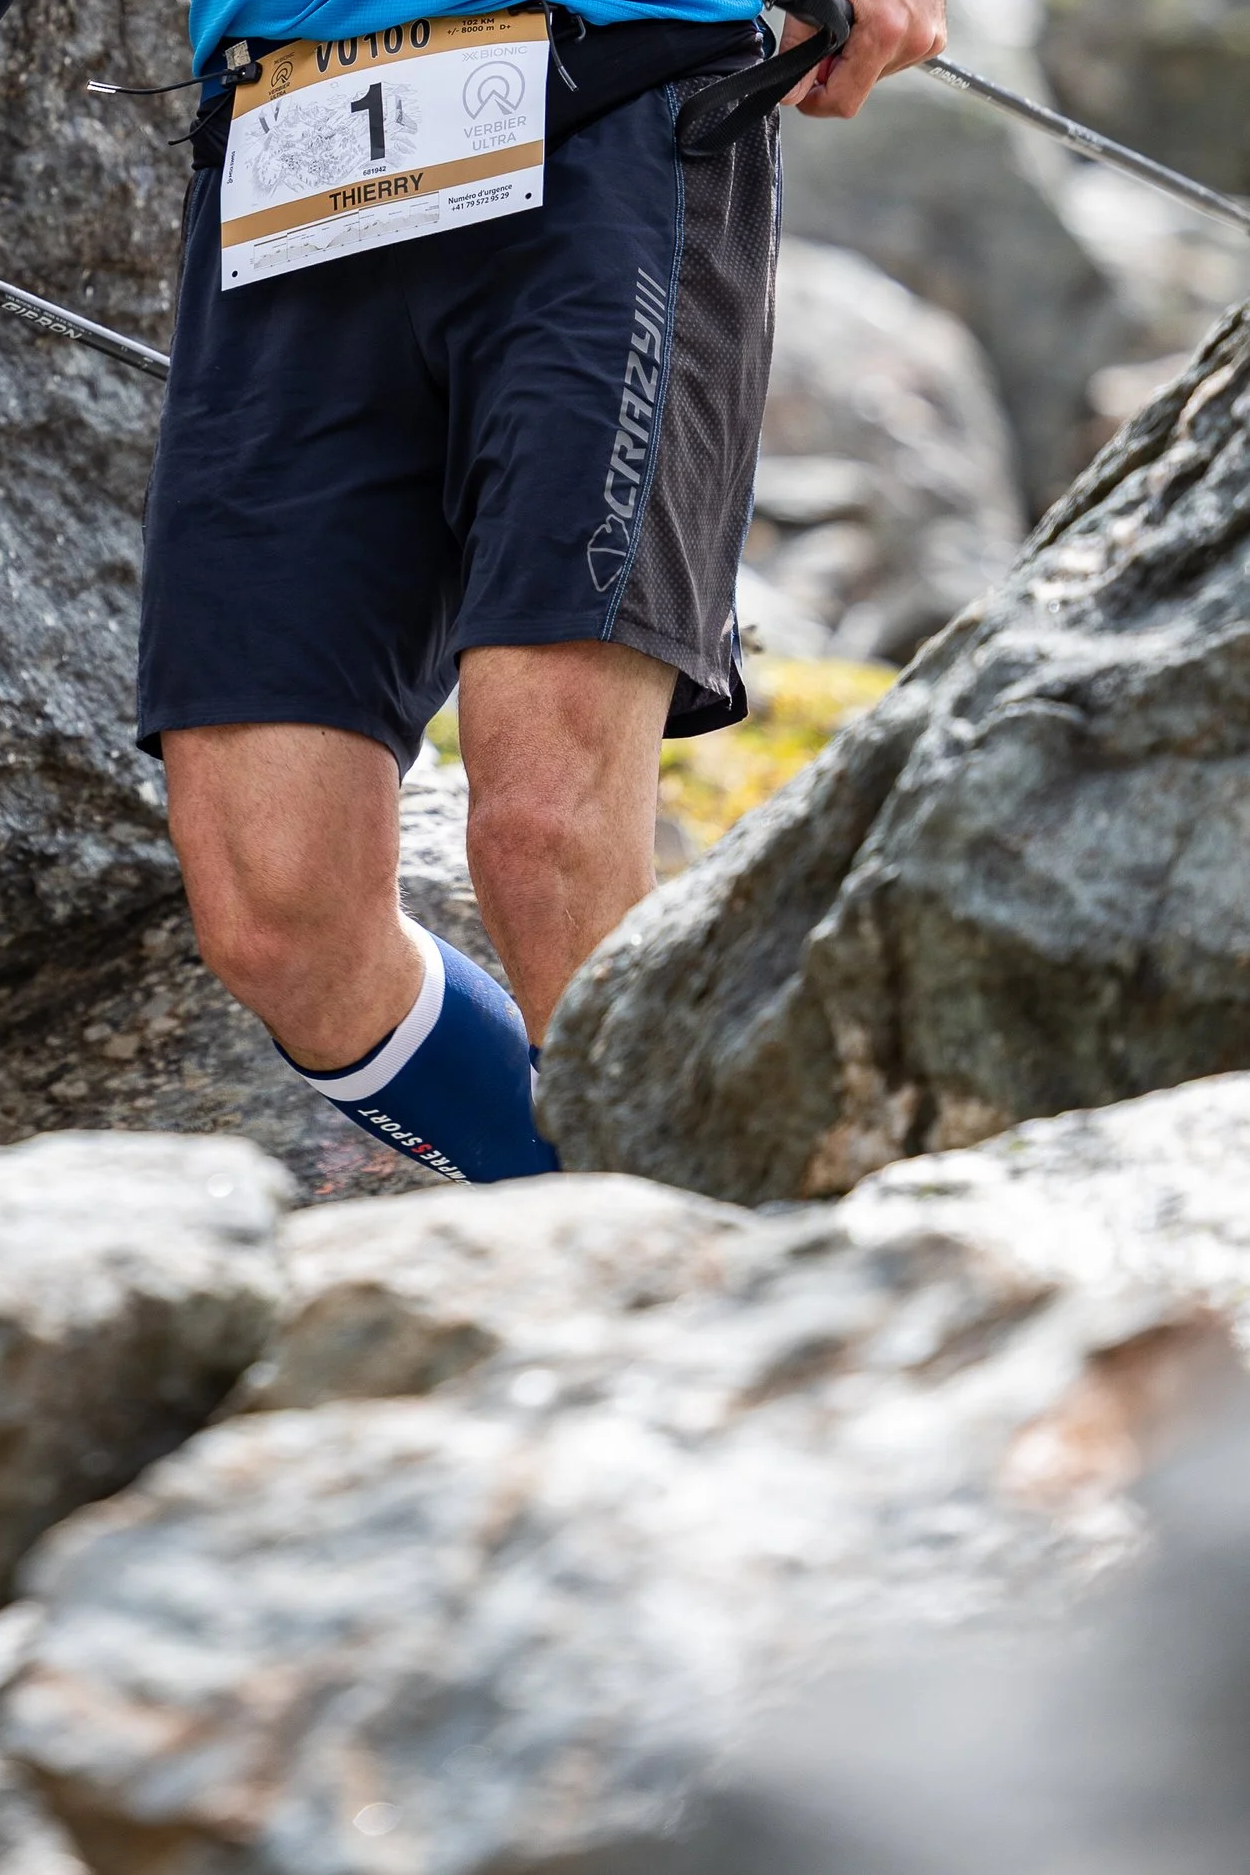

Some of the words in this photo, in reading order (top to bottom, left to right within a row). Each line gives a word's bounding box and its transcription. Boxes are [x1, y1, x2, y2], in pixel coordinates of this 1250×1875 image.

[462, 18, 478, 26] 102
[350, 82, 385, 161] 1
[464, 115, 526, 138] VERBIER
[473, 132, 516, 151] ULTRA
[362, 166, 387, 176] 681942
[329, 173, 424, 211] THIERRY
[448, 193, 476, 204] Numéro
[478, 184, 512, 197] d'urgence
[452, 203, 464, 211] +41
[476, 197, 489, 206] 572
[490, 194, 499, 202] 95
[604, 309, 662, 518] CRAZY
[358, 1109, 474, 1187] OMPRESSPORT
